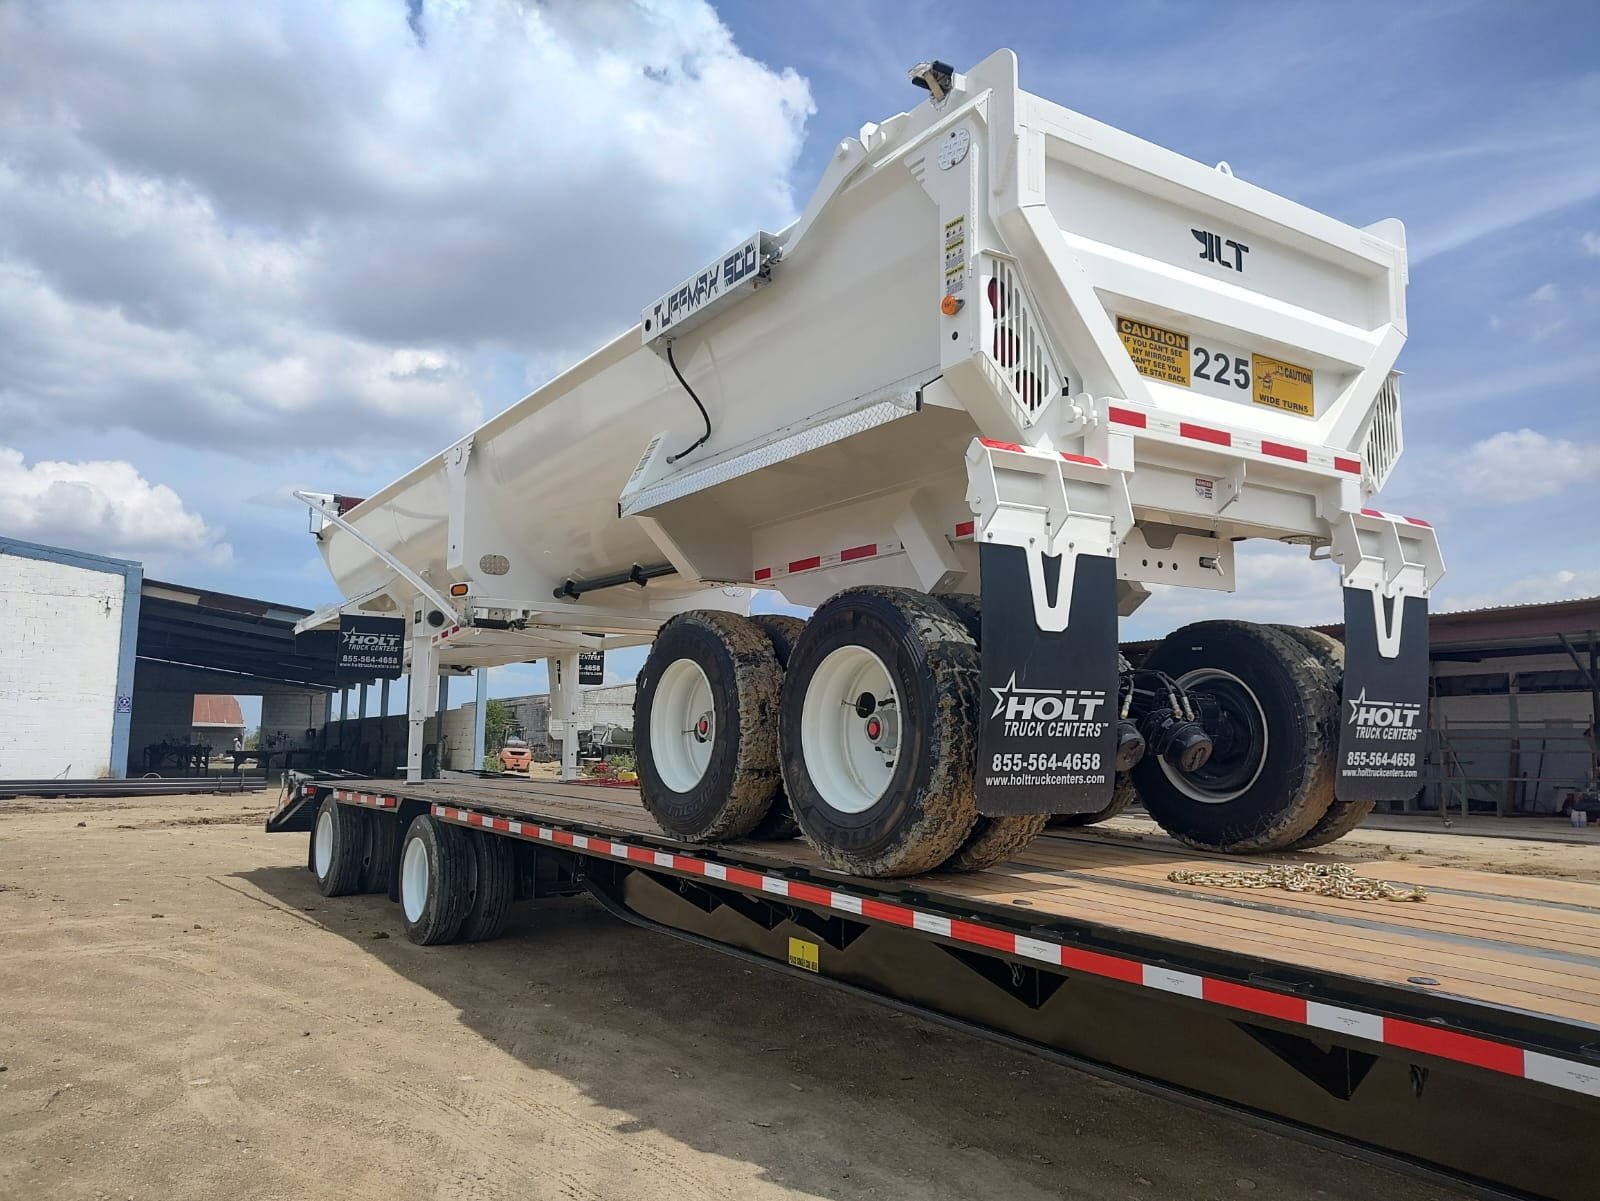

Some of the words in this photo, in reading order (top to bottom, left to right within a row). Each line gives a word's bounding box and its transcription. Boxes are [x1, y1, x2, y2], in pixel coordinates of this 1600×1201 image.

[723, 241, 757, 288] 500
[1120, 320, 1186, 349] CAUTION
[1124, 335, 1131, 344] IF
[1133, 337, 1148, 348] YOU
[1149, 342, 1169, 354] CAN'T
[1170, 348, 1183, 358] SEE
[1133, 347, 1143, 356] MY
[1145, 350, 1176, 364] MIRRORS
[1131, 355, 1151, 366] CAN'T
[1153, 360, 1166, 370] SEE
[1167, 364, 1182, 374] YOU
[1193, 346, 1250, 390] 225
[1149, 368, 1167, 378] STAY
[1168, 373, 1186, 383] BACK
[1284, 367, 1312, 385] CAUTION
[1259, 393, 1280, 406] WIDE
[1282, 399, 1309, 413] TURNS
[349, 635, 400, 646] HOLT
[1005, 696, 1105, 721] HOLT
[1357, 706, 1420, 728] HOLT
[1004, 721, 1045, 737] TRUCK
[1355, 726, 1382, 740] TRUCK
[992, 753, 1101, 771] 855-564-4658
[1347, 752, 1416, 767] 855-564-4658
[985, 773, 1105, 786] www.holttruckcenters.com
[1342, 767, 1418, 778] www.holttruckcenters.com
